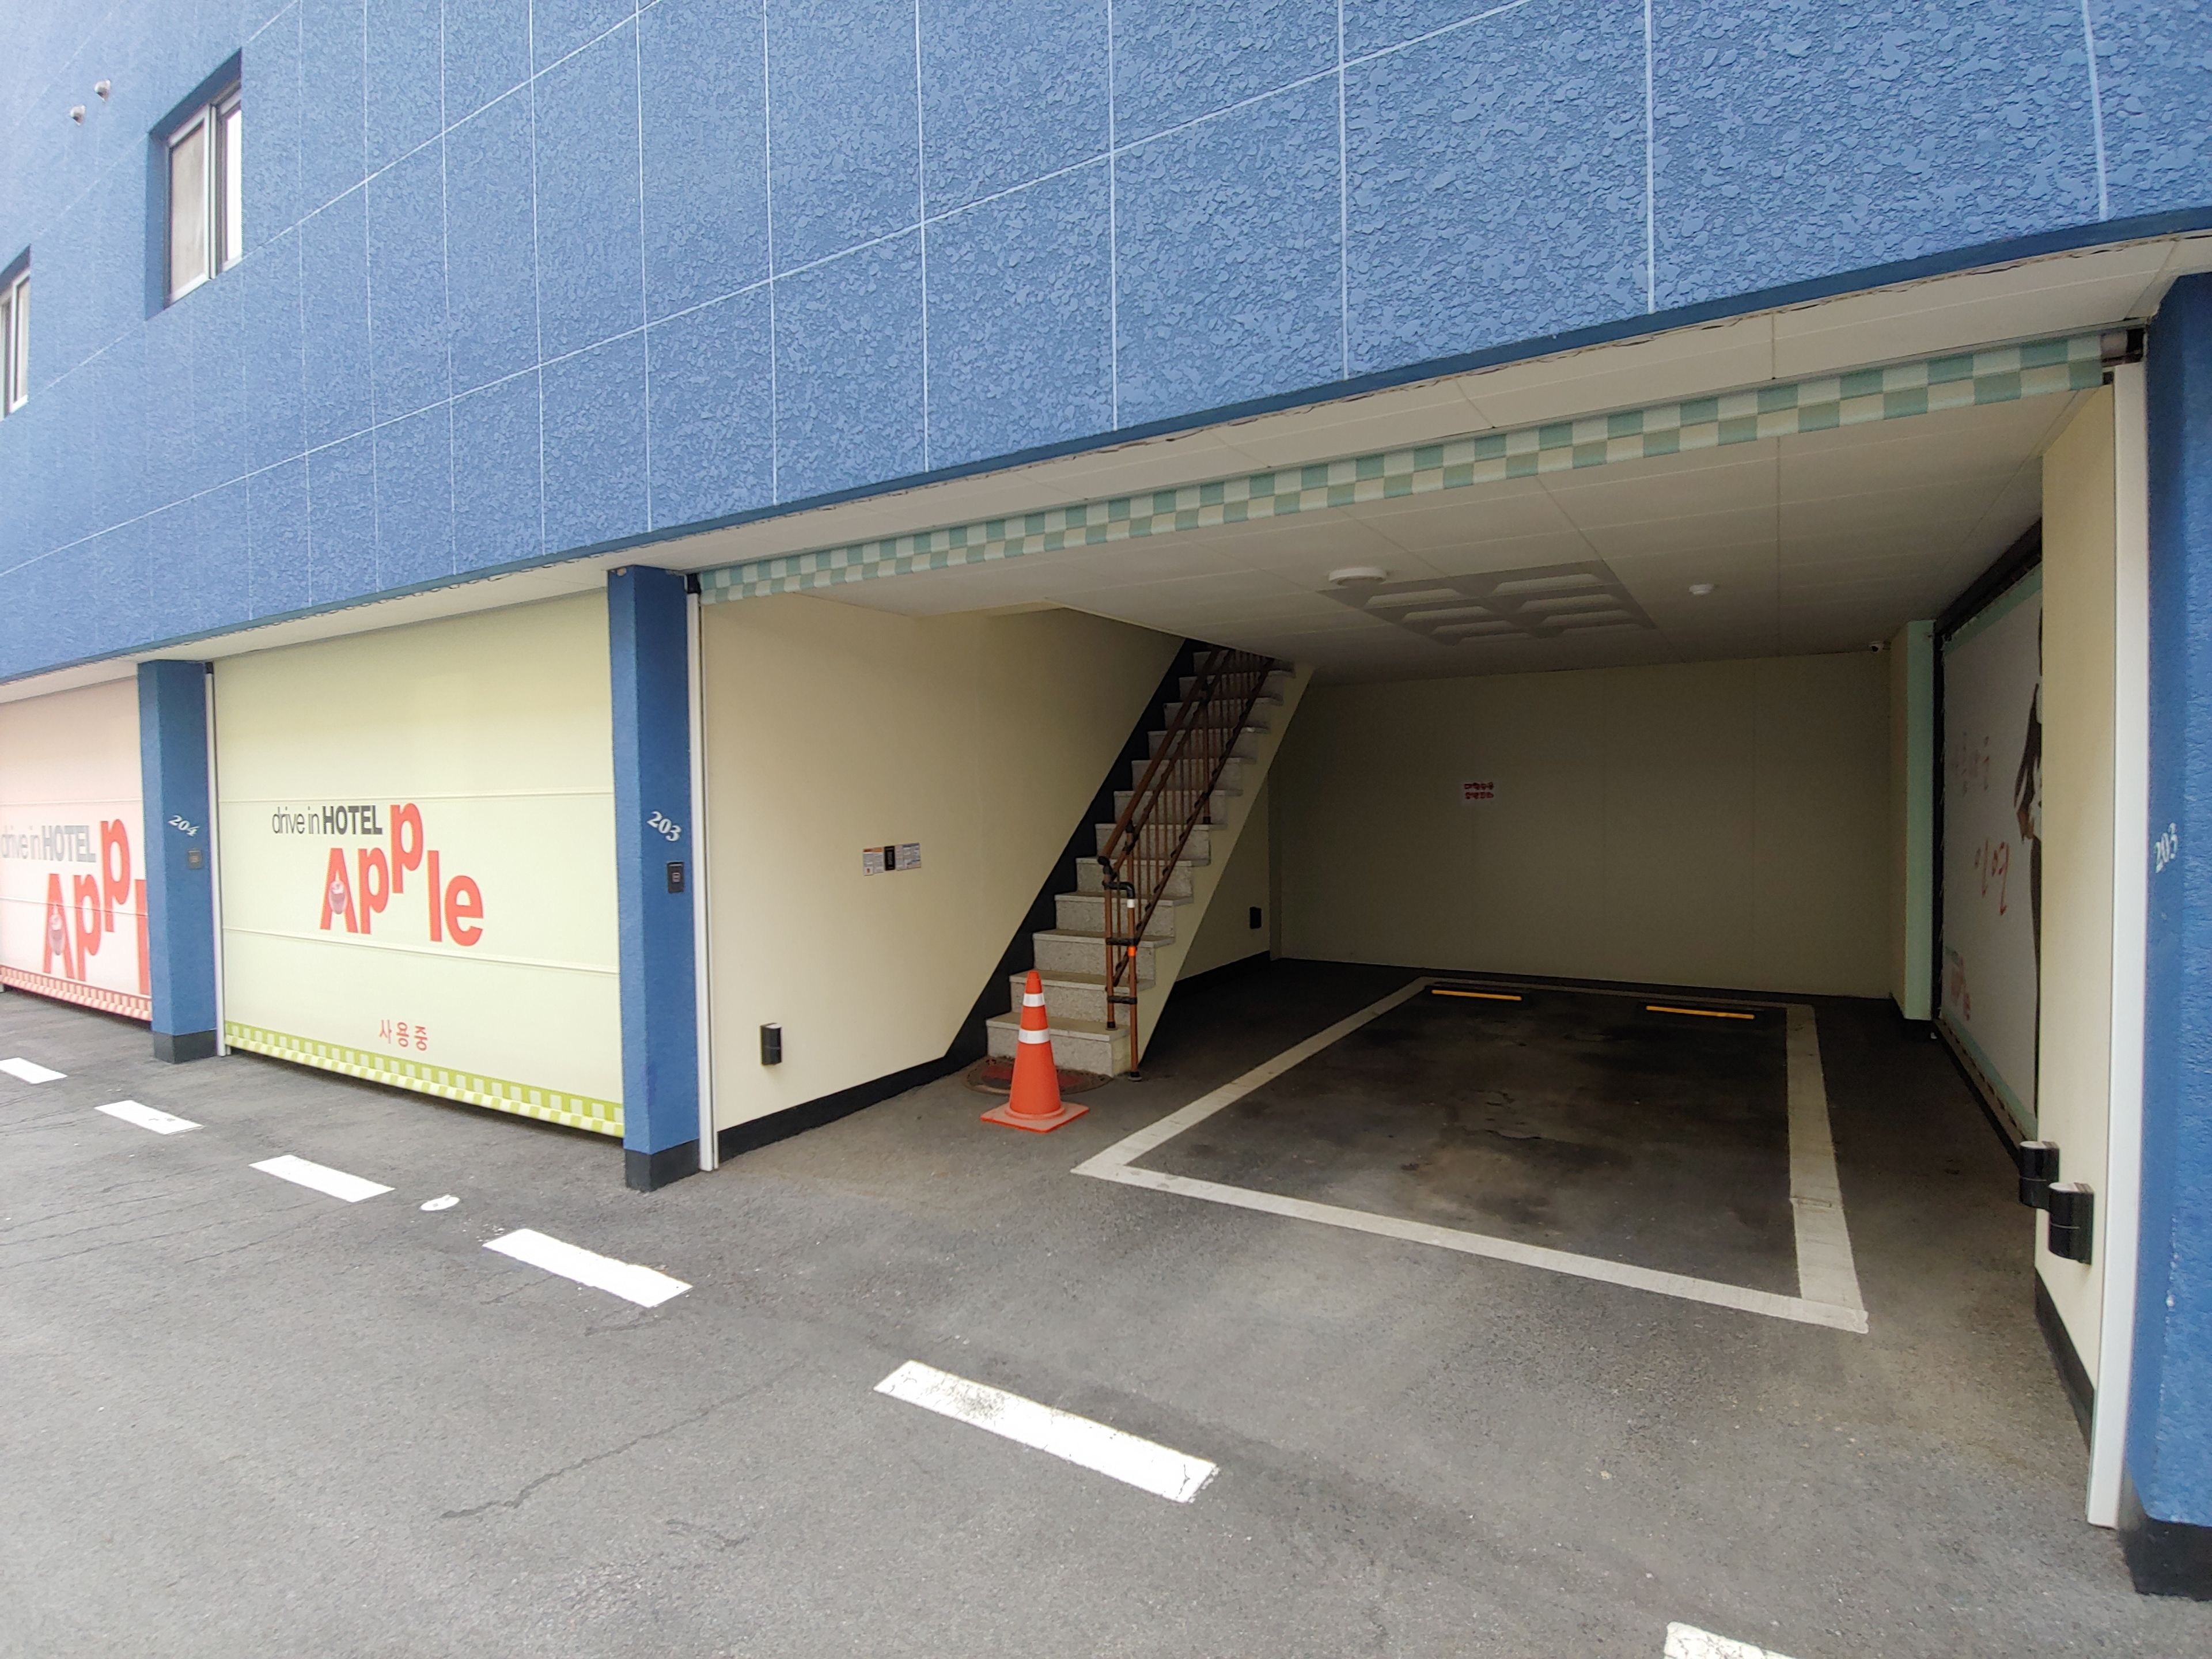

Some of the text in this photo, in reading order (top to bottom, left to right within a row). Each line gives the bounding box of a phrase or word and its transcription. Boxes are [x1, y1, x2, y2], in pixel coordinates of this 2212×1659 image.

[168, 815, 200, 836] 204
[272, 805, 382, 835] drive in HOTEL
[646, 811, 681, 841] 203
[29, 825, 41, 859] in
[41, 825, 96, 863] HOTEL
[2155, 822, 2178, 873] 203
[319, 802, 483, 946] Apple
[43, 819, 150, 995] Appl
[379, 1019, 428, 1051] 사용중
